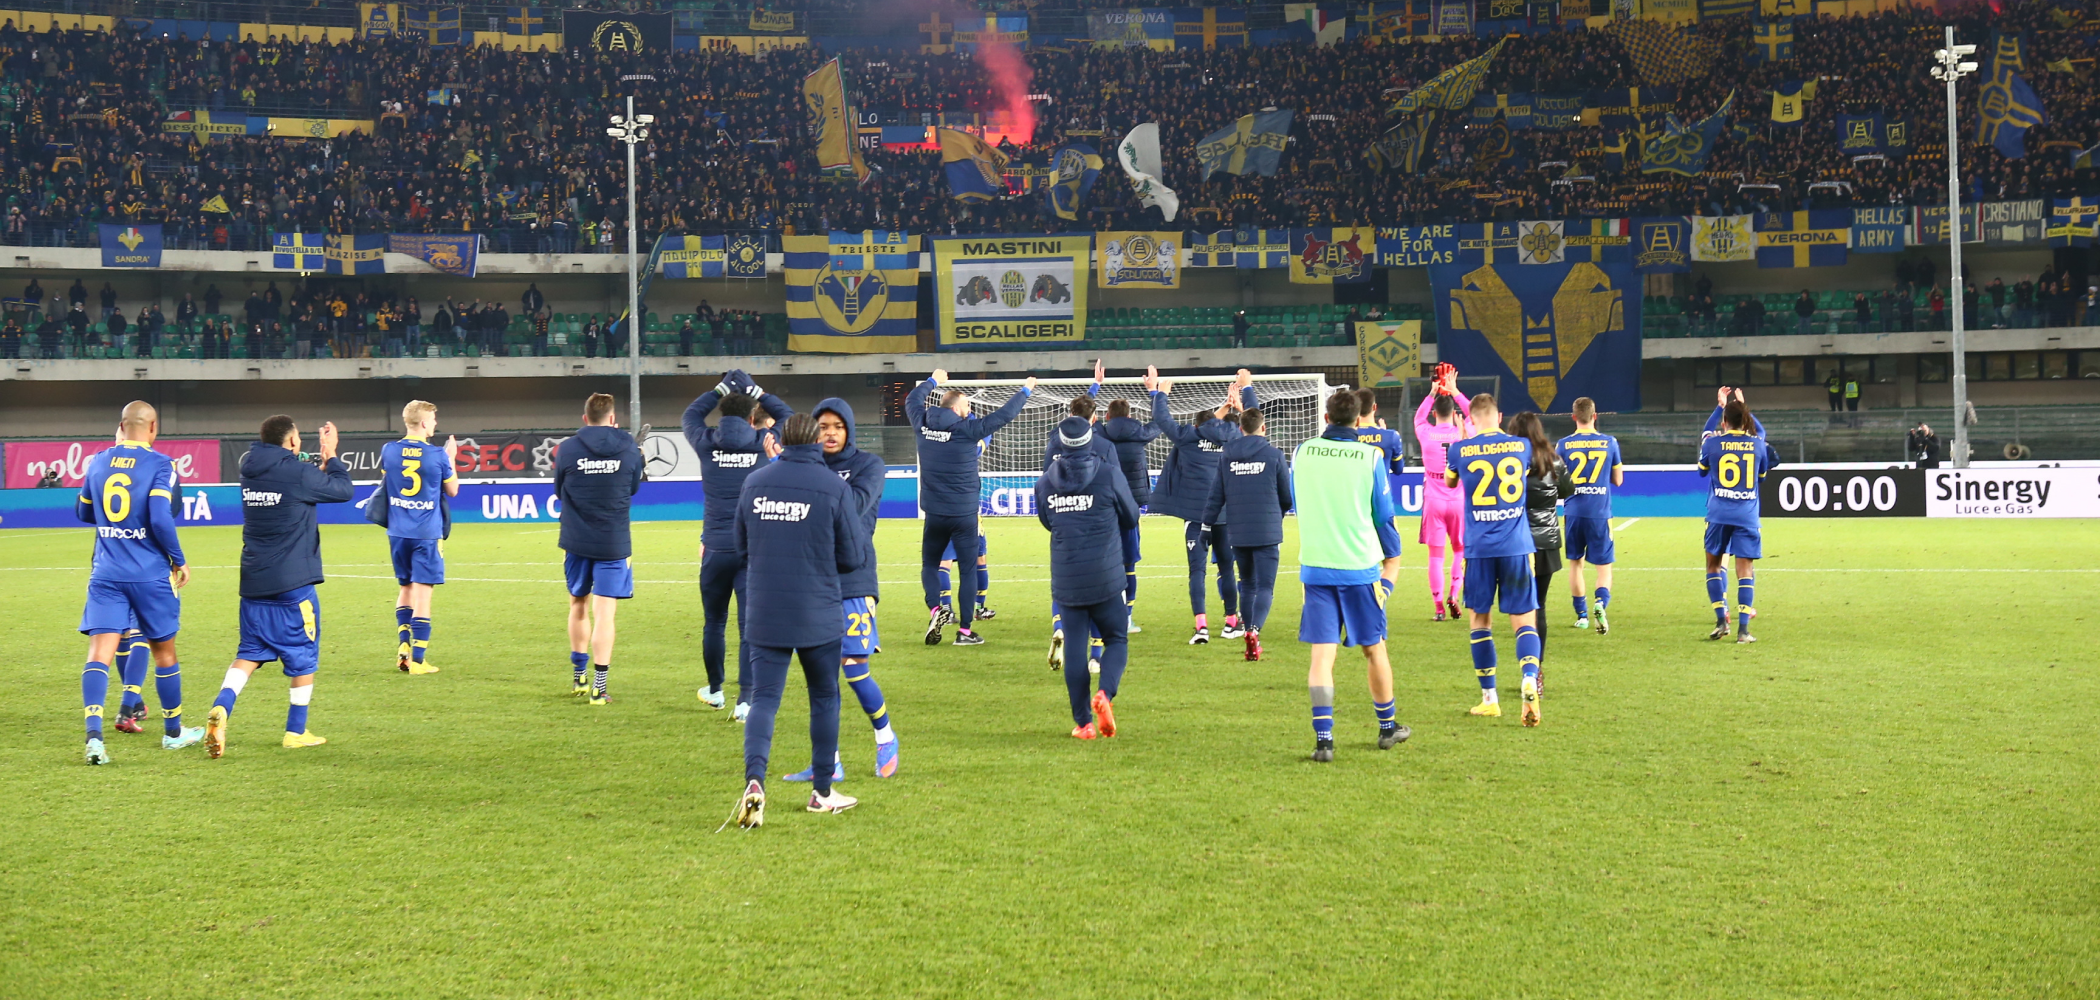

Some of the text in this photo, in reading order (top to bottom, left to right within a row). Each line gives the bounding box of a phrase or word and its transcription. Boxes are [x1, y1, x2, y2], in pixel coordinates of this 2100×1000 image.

[363, 20, 394, 30] ANGOLO
[1105, 12, 1166, 24] VERONA
[1855, 208, 1906, 226] HELLAS
[1984, 199, 2044, 224] CRISTIANO
[1382, 224, 1454, 240] WE ARE
[1766, 231, 1838, 244] VERONA
[1859, 229, 1895, 248] ARMY
[728, 237, 764, 255] HELLAS
[840, 244, 896, 254] TRIESTE
[962, 240, 1062, 256] MASTINI
[1402, 239, 1434, 253] FOR
[1460, 239, 1472, 248] WE
[1472, 239, 1490, 248] HATE
[329, 249, 367, 260] LAZISE
[1383, 250, 1454, 267] HELLAS
[729, 257, 765, 275] ALCOOL
[955, 322, 1074, 340] SCALIGERI
[920, 425, 952, 441] Sinergy
[401, 447, 423, 458] DOIG
[1306, 445, 1364, 460] macron
[1460, 440, 1525, 457] ABILDGAARD
[1564, 439, 1609, 450] DAWIDOWICZ
[1720, 441, 1755, 451] TAMEZE
[110, 456, 137, 469] HIEN
[576, 457, 622, 472] Sinergy
[711, 450, 758, 466] Sinergy
[1230, 461, 1266, 473] Sinergy
[1568, 450, 1608, 485] 27
[1718, 452, 1755, 490] 61
[400, 459, 422, 497] 3
[1467, 456, 1523, 506] 28
[102, 472, 132, 523] 6
[242, 487, 283, 505] Sinergy
[1778, 475, 1898, 512] 00:00
[1935, 472, 2051, 508] Sinergy
[481, 494, 539, 520] UNA
[752, 496, 811, 520] Sinergy
[1047, 493, 1094, 509] Sinergy
[1955, 503, 2034, 514] Luce e Gas
[760, 512, 779, 521] Luce
[785, 513, 800, 522] Gas
[846, 612, 872, 636] 25
